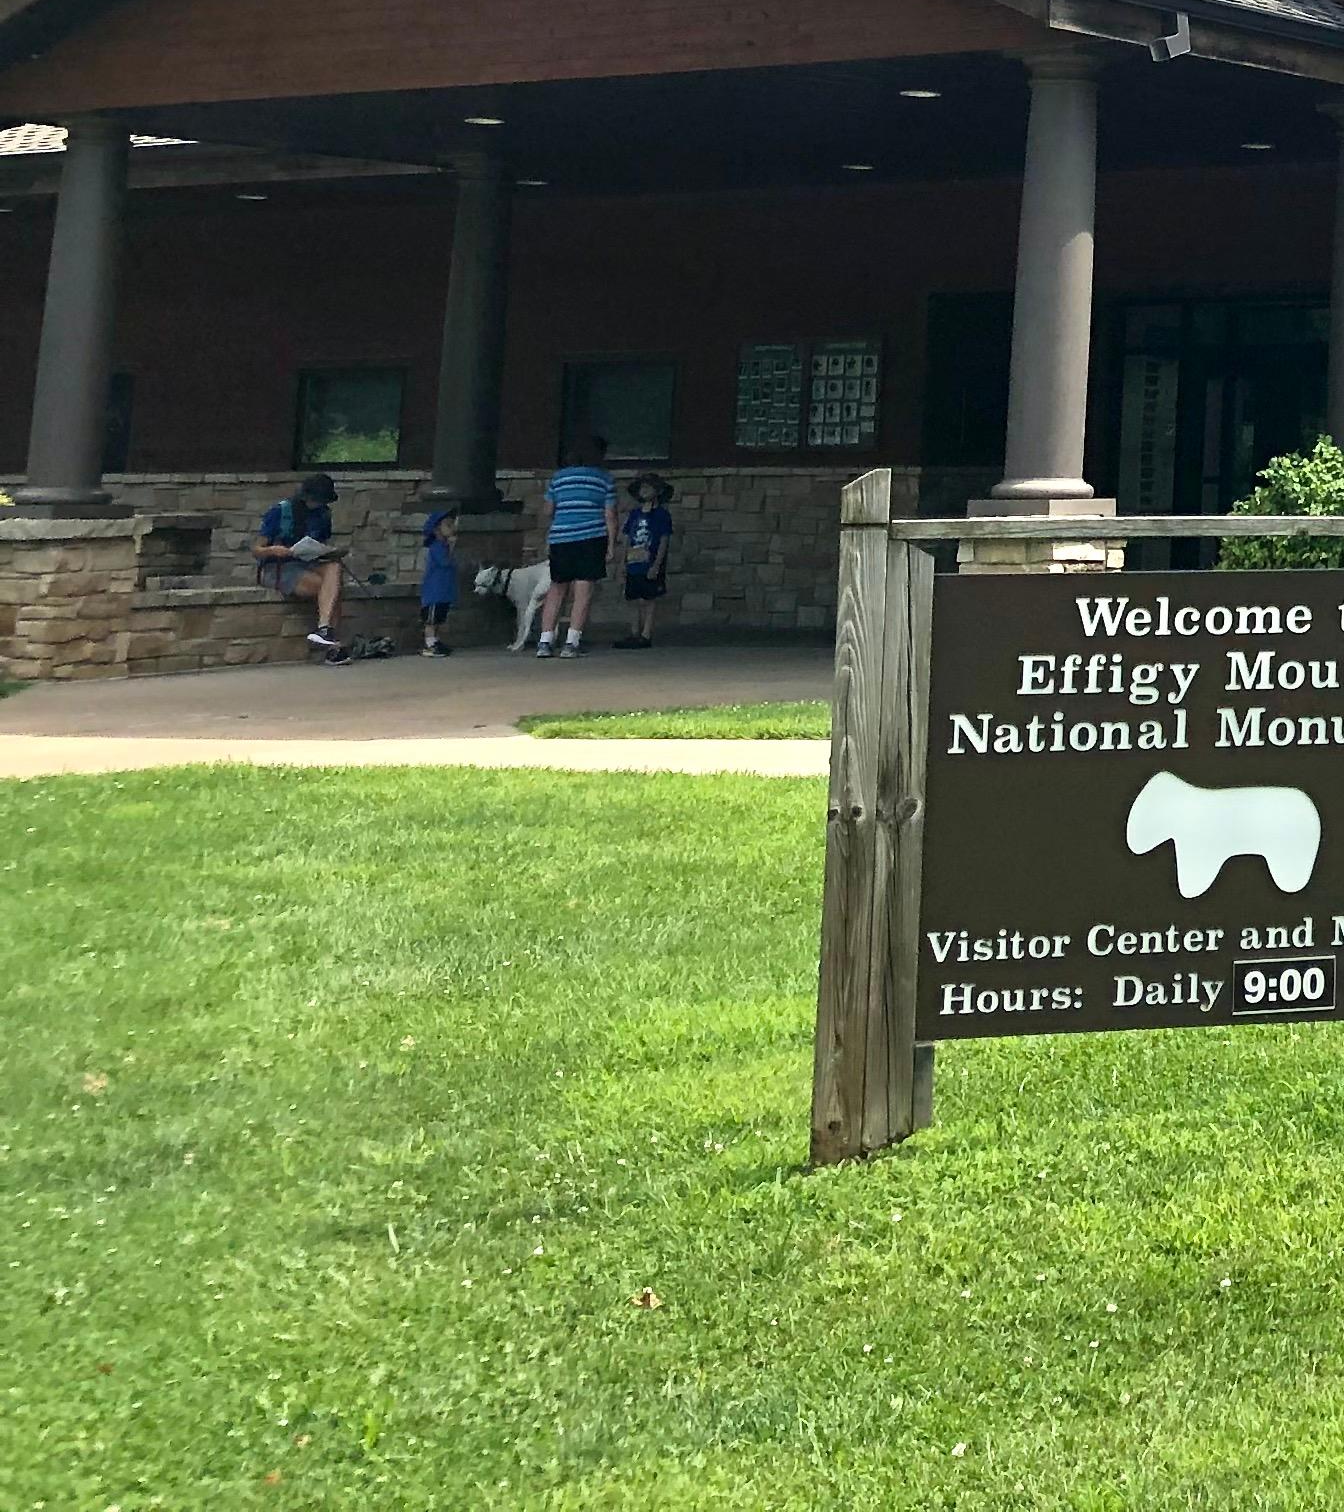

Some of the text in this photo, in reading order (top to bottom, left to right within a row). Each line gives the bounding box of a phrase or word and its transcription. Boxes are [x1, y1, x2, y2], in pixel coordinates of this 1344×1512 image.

[1076, 596, 1313, 637] Welcome
[1017, 654, 1201, 705] Effigy
[947, 709, 1189, 754] National
[926, 929, 1071, 963] Visitor
[1088, 924, 1225, 956] Center
[1240, 917, 1315, 950] and
[940, 983, 1083, 1016] Hours:
[1113, 973, 1225, 1013] Daily
[1244, 967, 1326, 1004] 9:00
